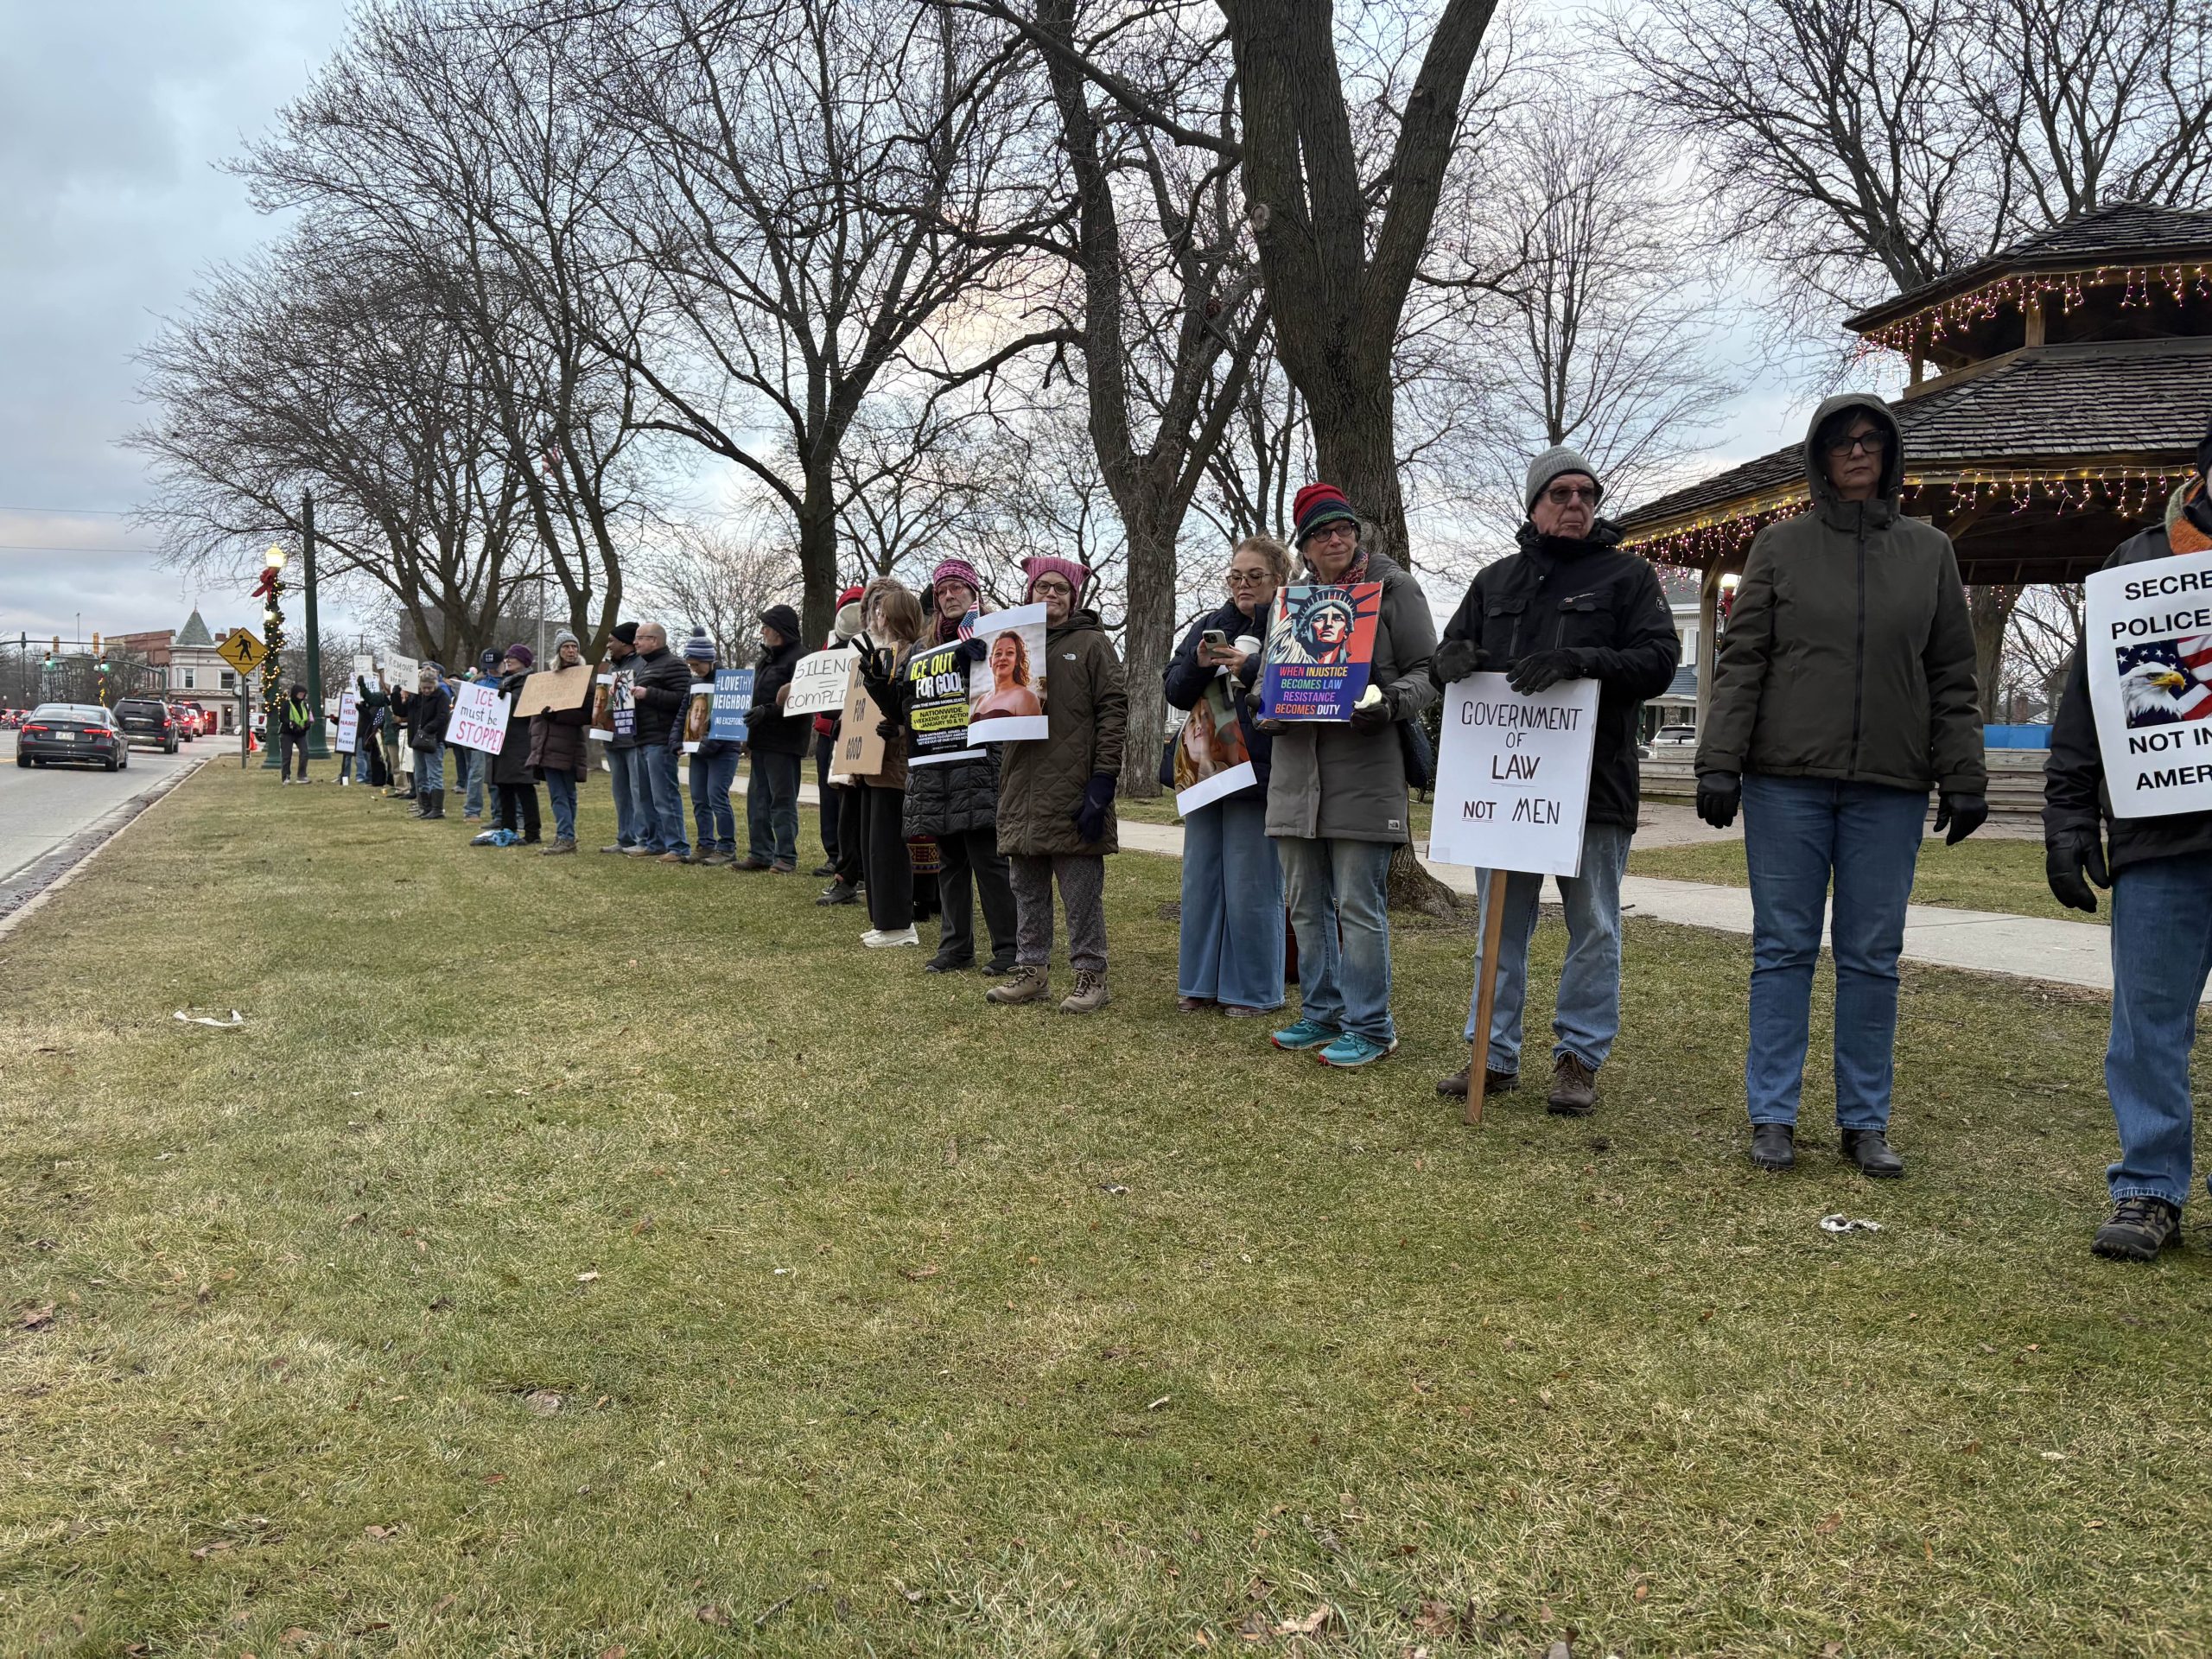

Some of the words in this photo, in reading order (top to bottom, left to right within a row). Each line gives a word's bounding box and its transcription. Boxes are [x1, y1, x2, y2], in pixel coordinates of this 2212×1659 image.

[2125, 570, 2212, 601] SECRE
[2112, 608, 2211, 639] POLICE
[910, 658, 929, 681] ICE
[931, 652, 955, 677] OUT
[1279, 666, 1304, 677] WHEN
[1306, 666, 1349, 677] INJUSTICE
[916, 676, 934, 698] FOR
[1281, 678, 1322, 690] BECOMES
[1323, 679, 1343, 690] LAW
[475, 689, 494, 707] ICE
[713, 694, 752, 710] NEIGHBOR
[1283, 691, 1336, 702] RESISTANCE
[460, 706, 485, 721] must
[486, 709, 498, 726] be
[913, 715, 940, 724] WEEKEND
[919, 707, 963, 718] NATIONWIDE
[1274, 703, 1316, 715] BECOMES
[1317, 704, 1340, 715] DUTY
[1461, 701, 1583, 732] GOVERNMENT
[456, 721, 505, 753] STOPPED
[846, 736, 862, 760] GOOD
[1505, 732, 1528, 748] OF
[2128, 730, 2185, 754] NOT
[1491, 753, 1541, 780] LAW
[2136, 764, 2212, 791] AMER
[1463, 800, 1497, 819] NOT
[1511, 798, 1560, 824] MEN
